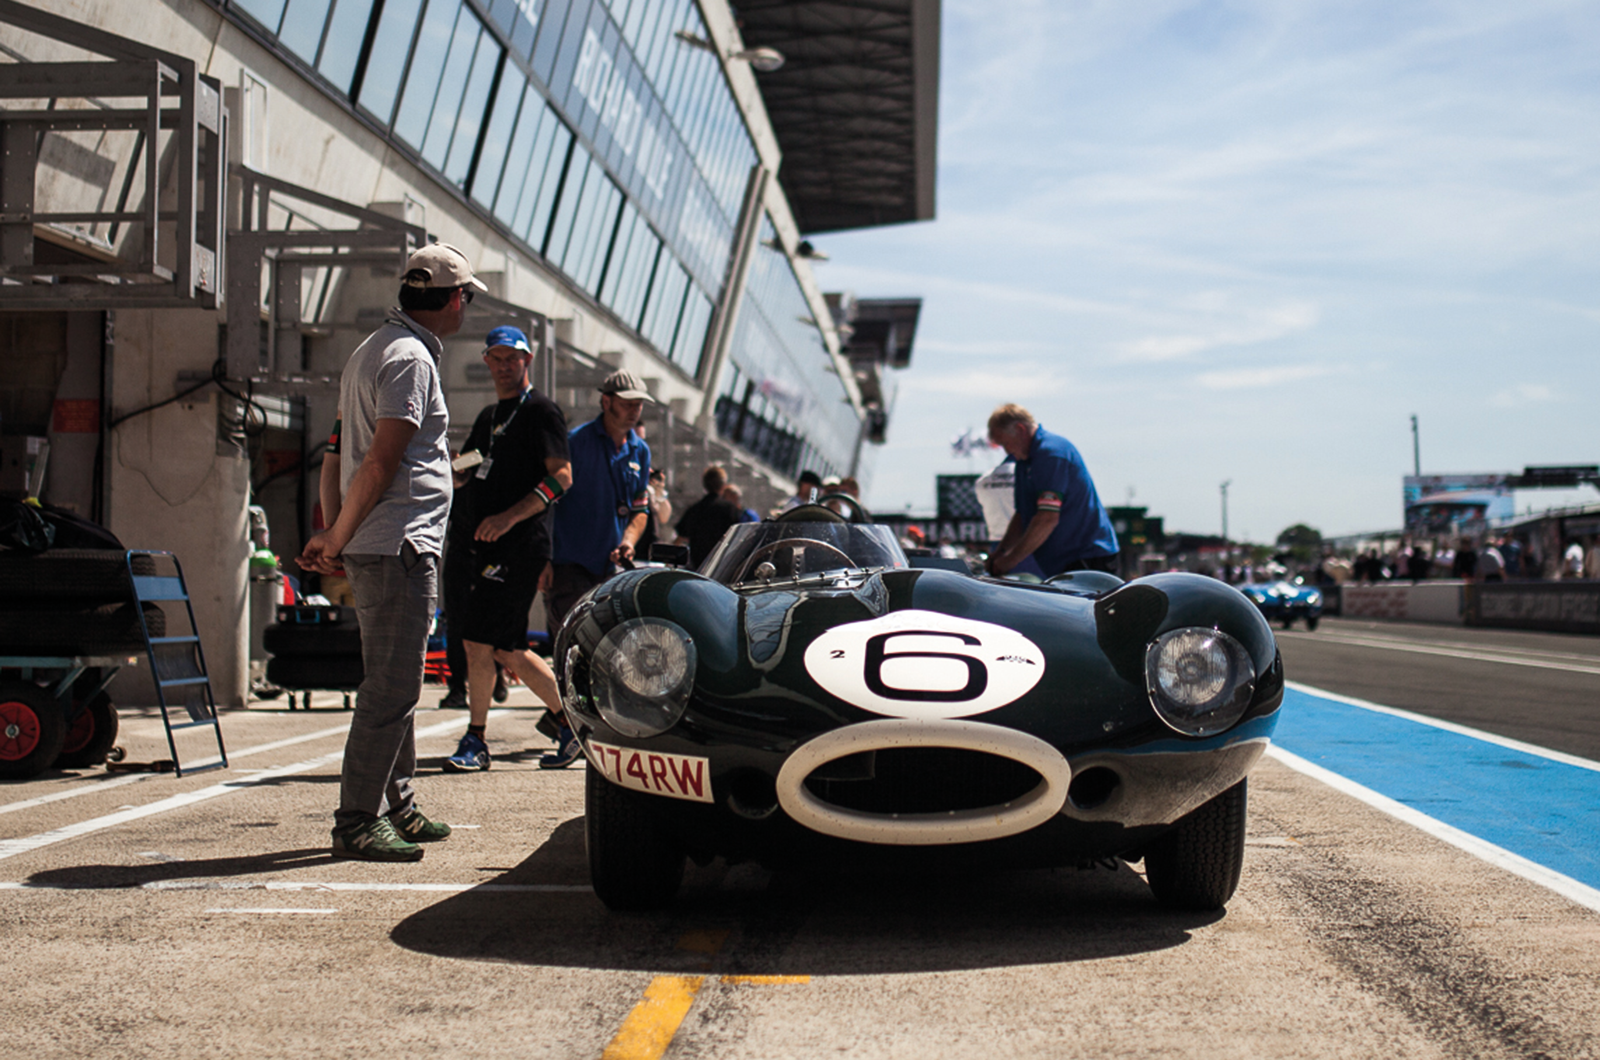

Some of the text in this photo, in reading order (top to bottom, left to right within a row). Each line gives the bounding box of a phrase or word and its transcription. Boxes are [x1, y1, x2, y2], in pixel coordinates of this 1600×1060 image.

[830, 630, 988, 703] 2 6
[592, 744, 703, 797] 774RW
